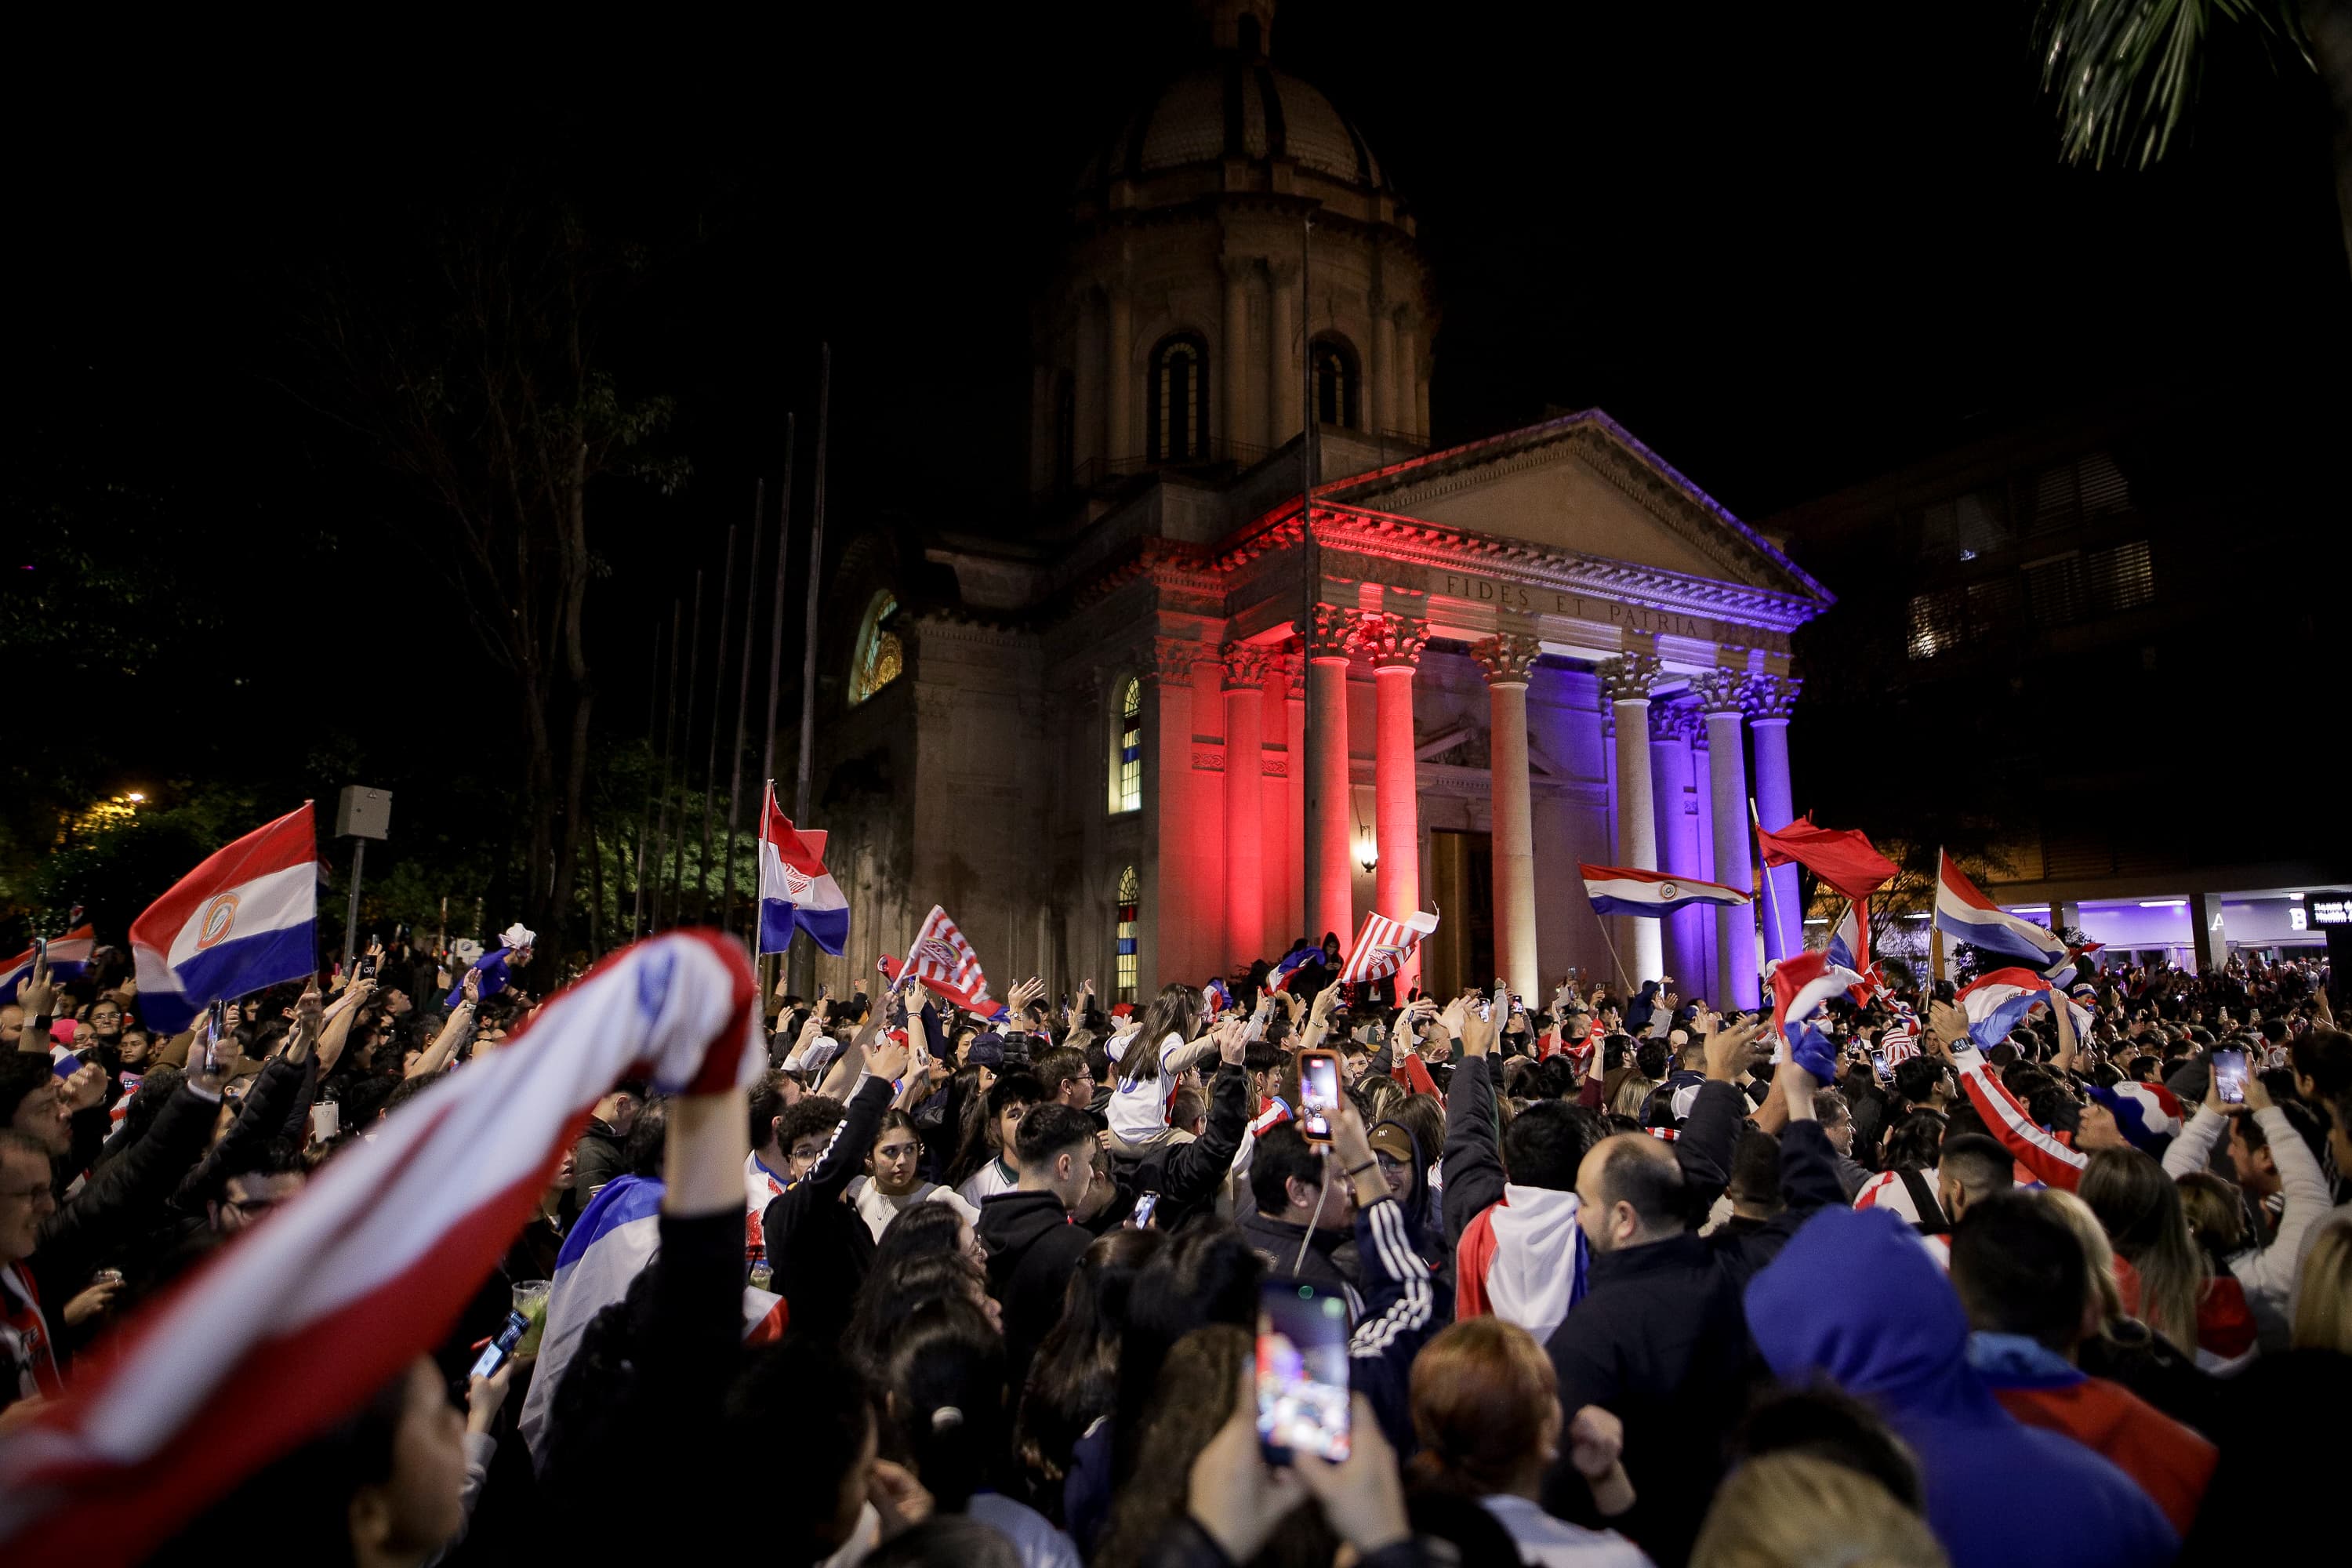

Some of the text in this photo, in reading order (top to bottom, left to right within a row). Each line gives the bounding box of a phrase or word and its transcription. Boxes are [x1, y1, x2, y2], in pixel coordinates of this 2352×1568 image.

[1447, 575, 1697, 636] FIDES ET PATRIA
